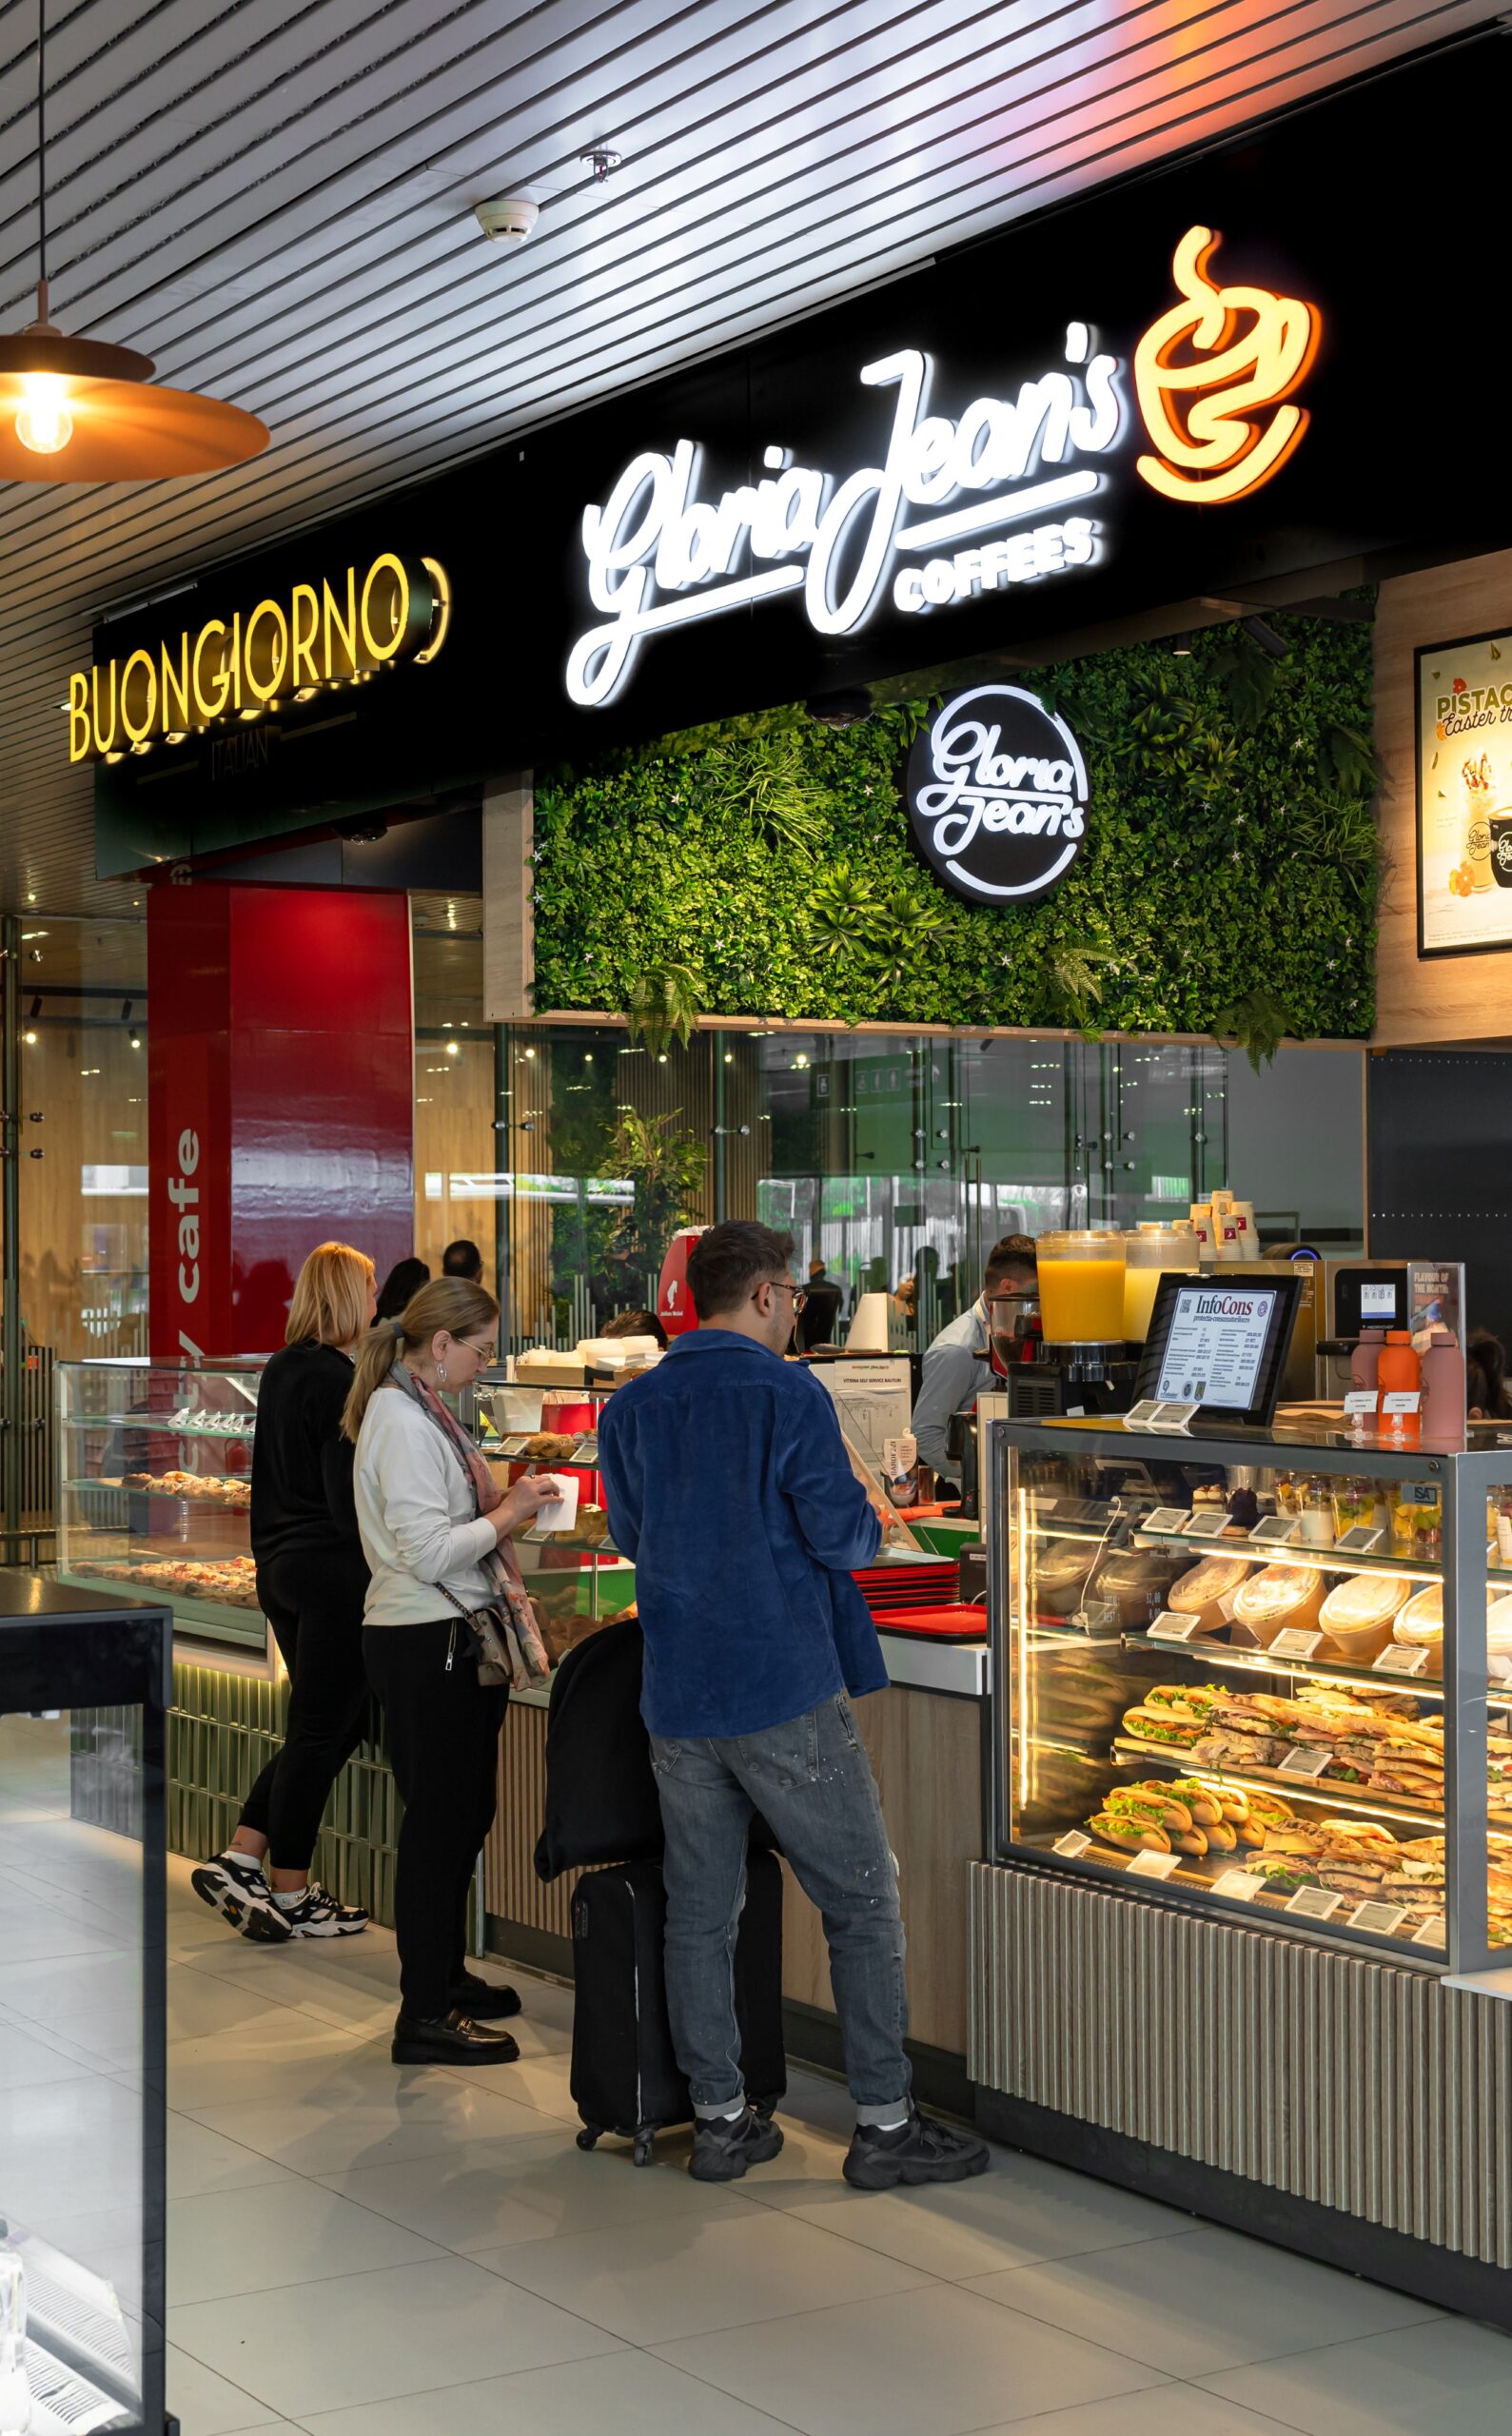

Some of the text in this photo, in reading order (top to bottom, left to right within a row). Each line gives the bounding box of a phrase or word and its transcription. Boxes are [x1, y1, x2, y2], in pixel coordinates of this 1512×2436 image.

[566, 321, 1123, 706] Gloria Jean's
[893, 518, 1102, 613] COFFEES
[69, 553, 409, 763] BUONGIORNO
[210, 725, 269, 782] ITALIAN
[1443, 712, 1497, 737] Easter
[916, 721, 1085, 855] Gloria Jean's
[168, 1129, 200, 1304] cafe
[1196, 1294, 1253, 1316] InfoCons
[1414, 1284, 1425, 1294] THE
[1441, 1272, 1449, 1283] OF
